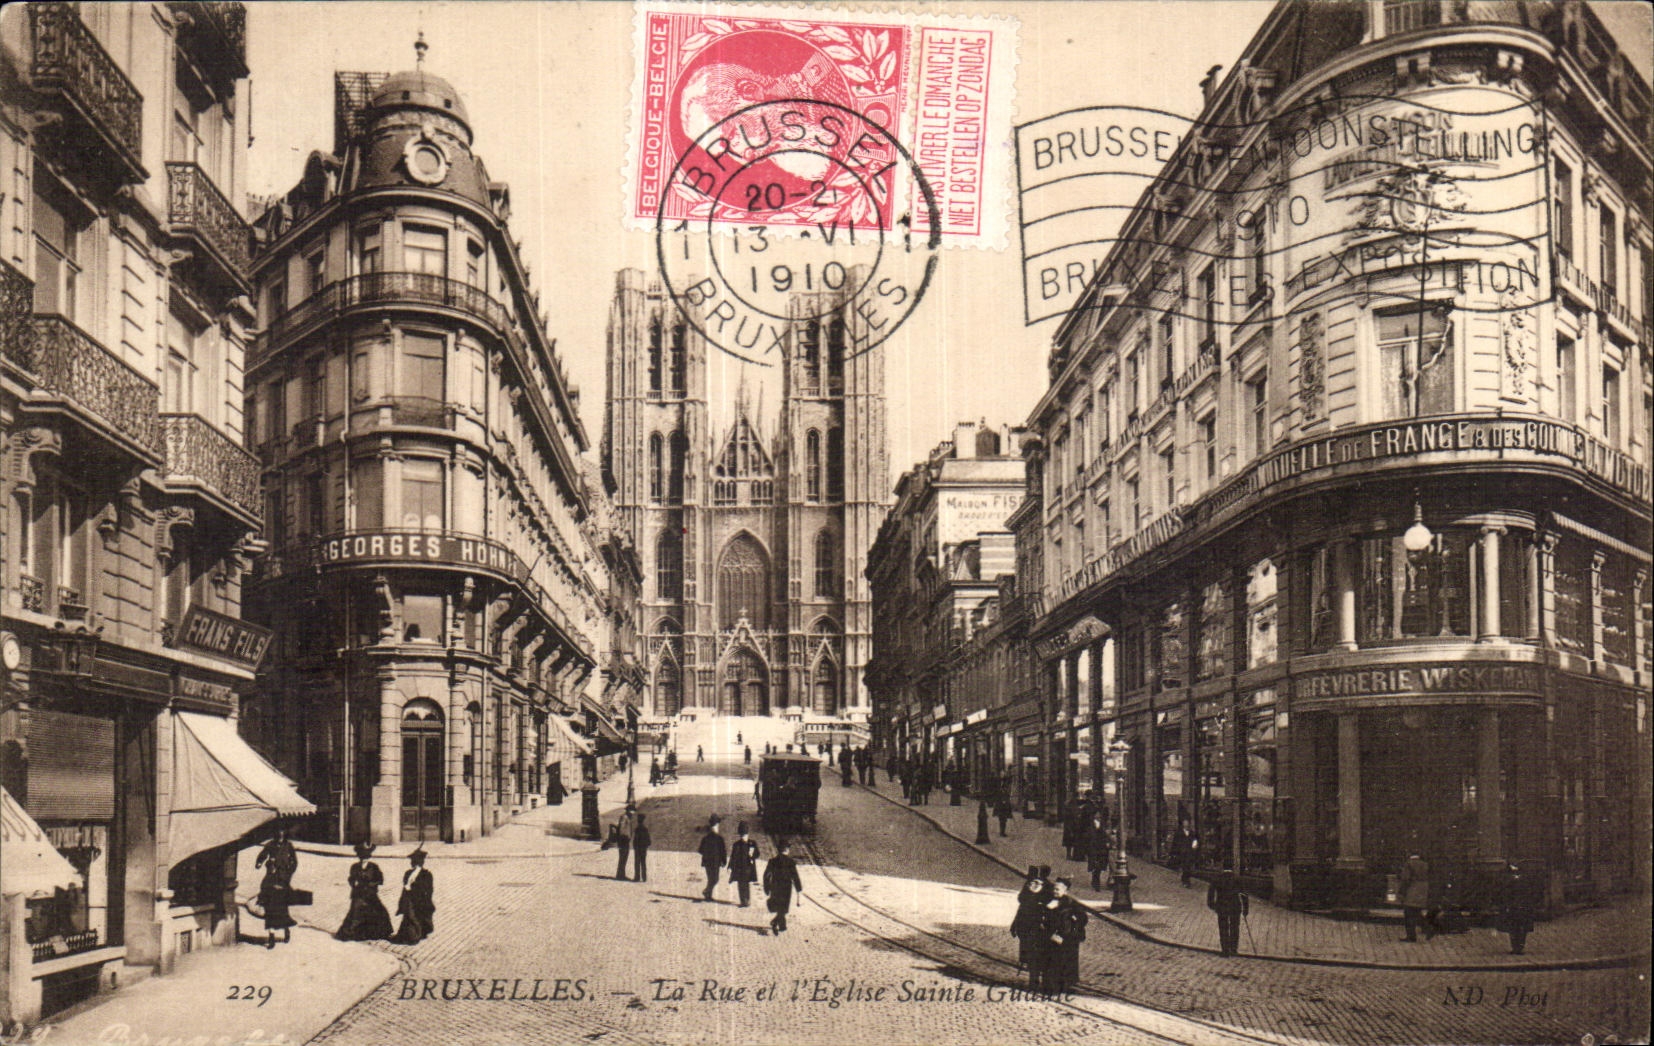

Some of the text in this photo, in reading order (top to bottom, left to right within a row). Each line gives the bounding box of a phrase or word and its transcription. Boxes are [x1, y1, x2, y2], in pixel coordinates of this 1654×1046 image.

[924, 36, 956, 108] DIMANCHE
[923, 112, 951, 129] LE
[948, 37, 986, 227] NIET BESTELLEN OP ZONDAG
[682, 110, 898, 197] BRUSSEL
[919, 130, 949, 178] LIVRER
[1034, 124, 1193, 171] BRUSSEL
[733, 226, 769, 253] 13
[1215, 195, 1310, 244] 1910
[751, 261, 848, 293] 1910
[1302, 245, 1540, 294] EXPOSITION
[684, 277, 908, 359] BRUXELLES
[1341, 441, 1362, 462] DE
[1371, 421, 1470, 457] FRANCE
[1493, 427, 1521, 448] DES
[329, 535, 441, 561] GEORGES
[186, 614, 266, 661] FRANS FILS
